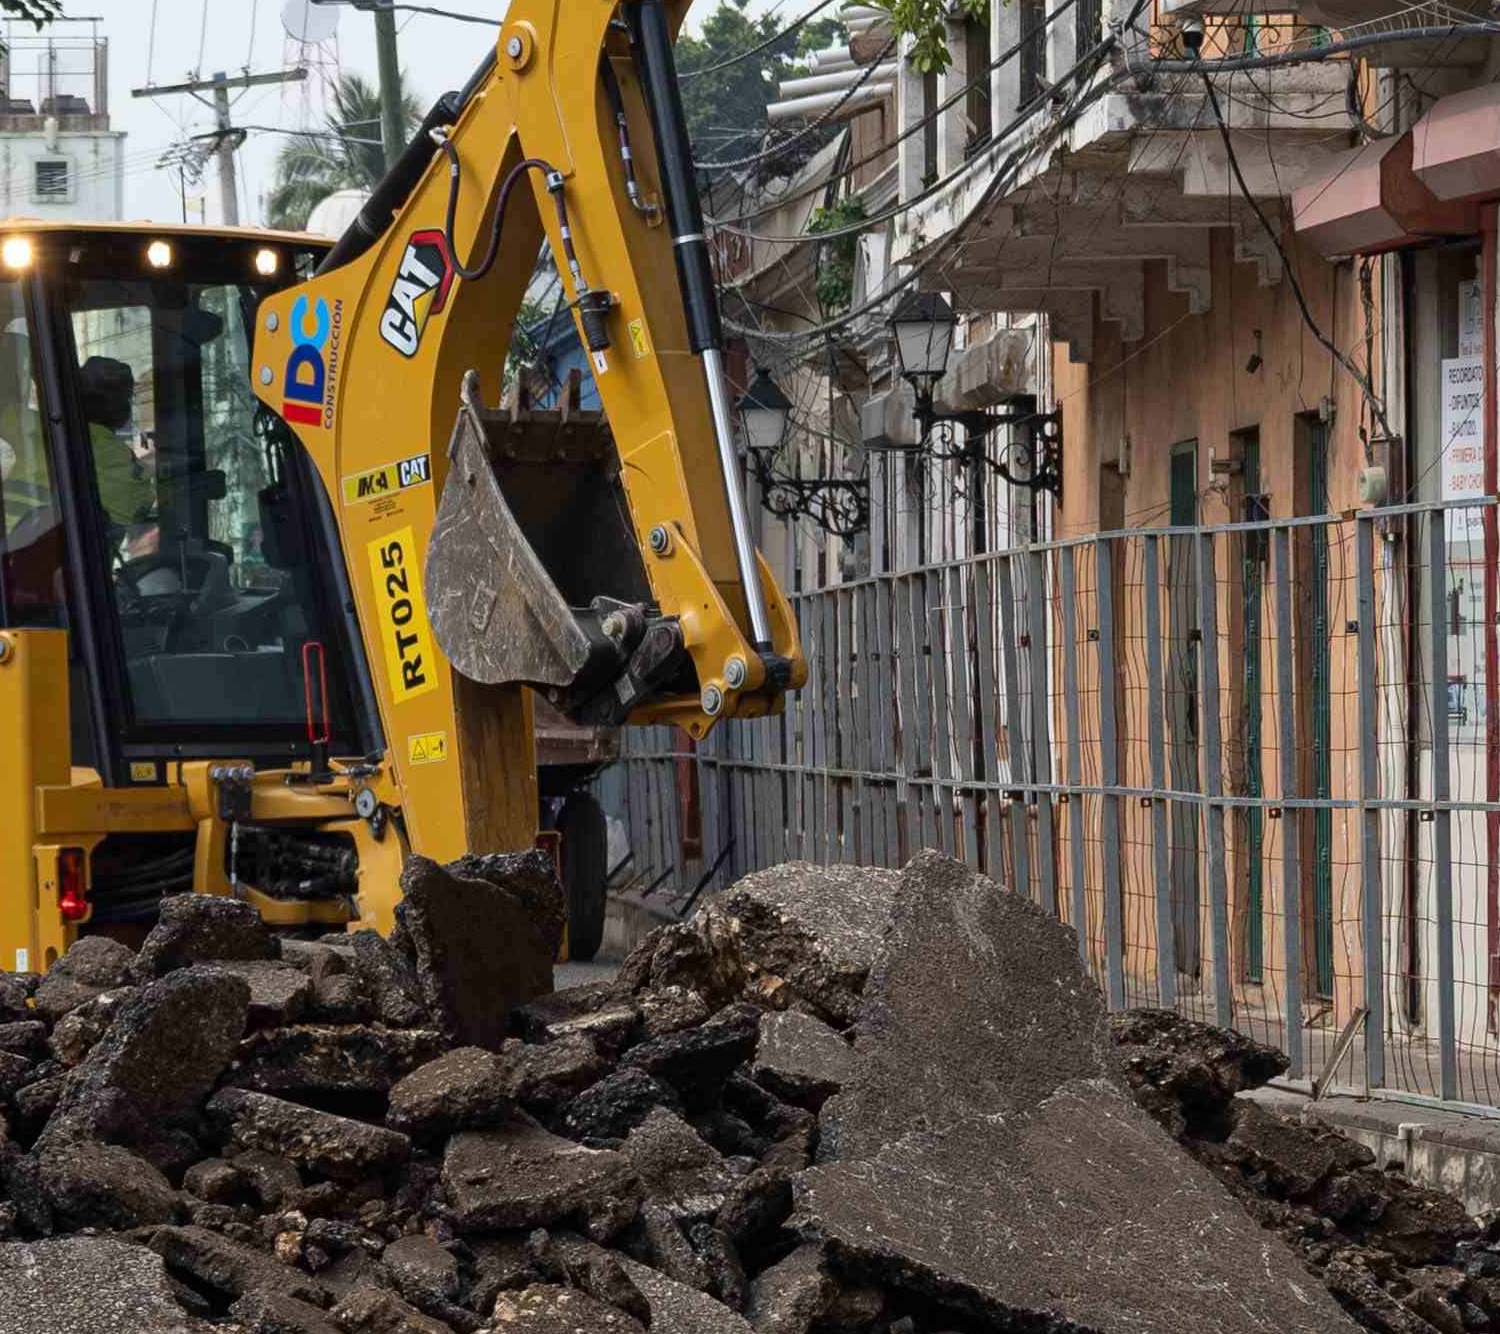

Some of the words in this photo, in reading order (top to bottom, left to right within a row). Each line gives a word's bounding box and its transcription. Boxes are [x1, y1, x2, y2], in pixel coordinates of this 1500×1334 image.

[282, 293, 330, 428] IDC
[379, 243, 441, 357] CAT
[400, 456, 427, 486] CAT
[379, 540, 426, 691] RT025
